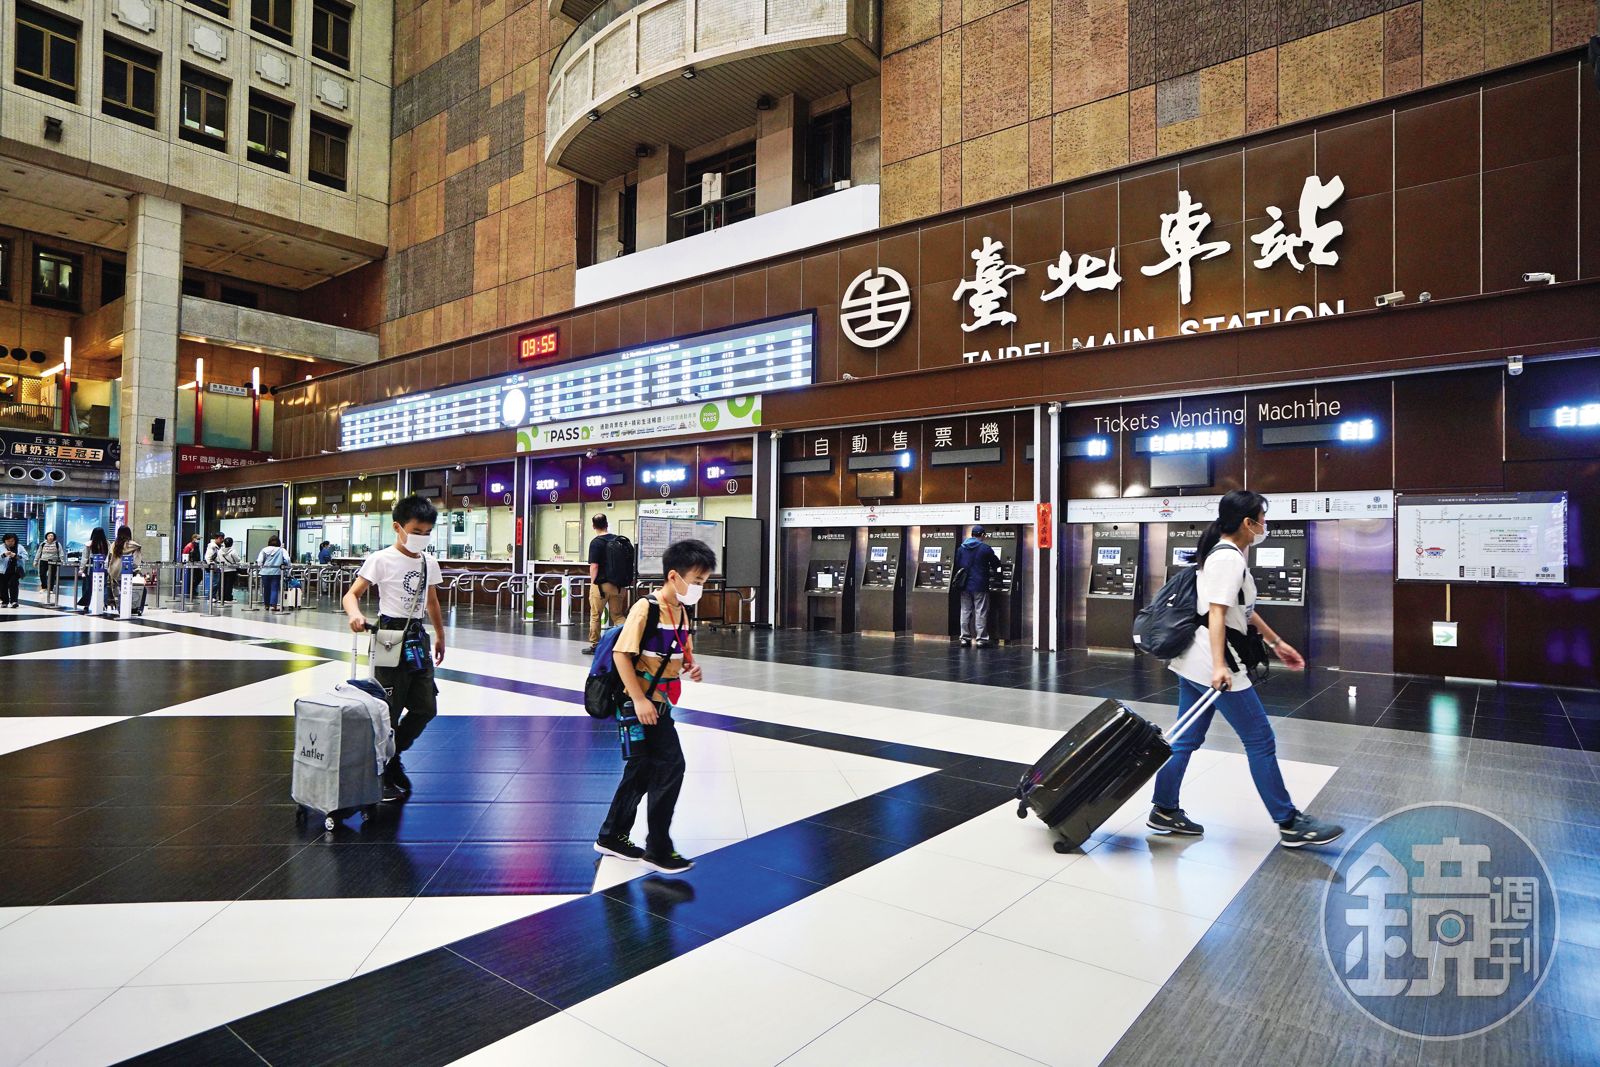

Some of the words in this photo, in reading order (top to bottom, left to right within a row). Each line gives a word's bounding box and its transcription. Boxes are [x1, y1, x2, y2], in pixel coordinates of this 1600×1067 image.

[952, 175, 1345, 333] 臺北車站
[522, 334, 555, 358] 09:55
[1094, 413, 1160, 433] Tickets
[1171, 408, 1244, 429] Vending
[1258, 399, 1341, 421] Machine
[543, 426, 580, 443] TPASS
[814, 422, 1000, 456] 自動售票機
[14, 443, 101, 460] 鮮奶茶三冠王
[181, 454, 198, 462] B1F
[300, 745, 325, 761] Antler
